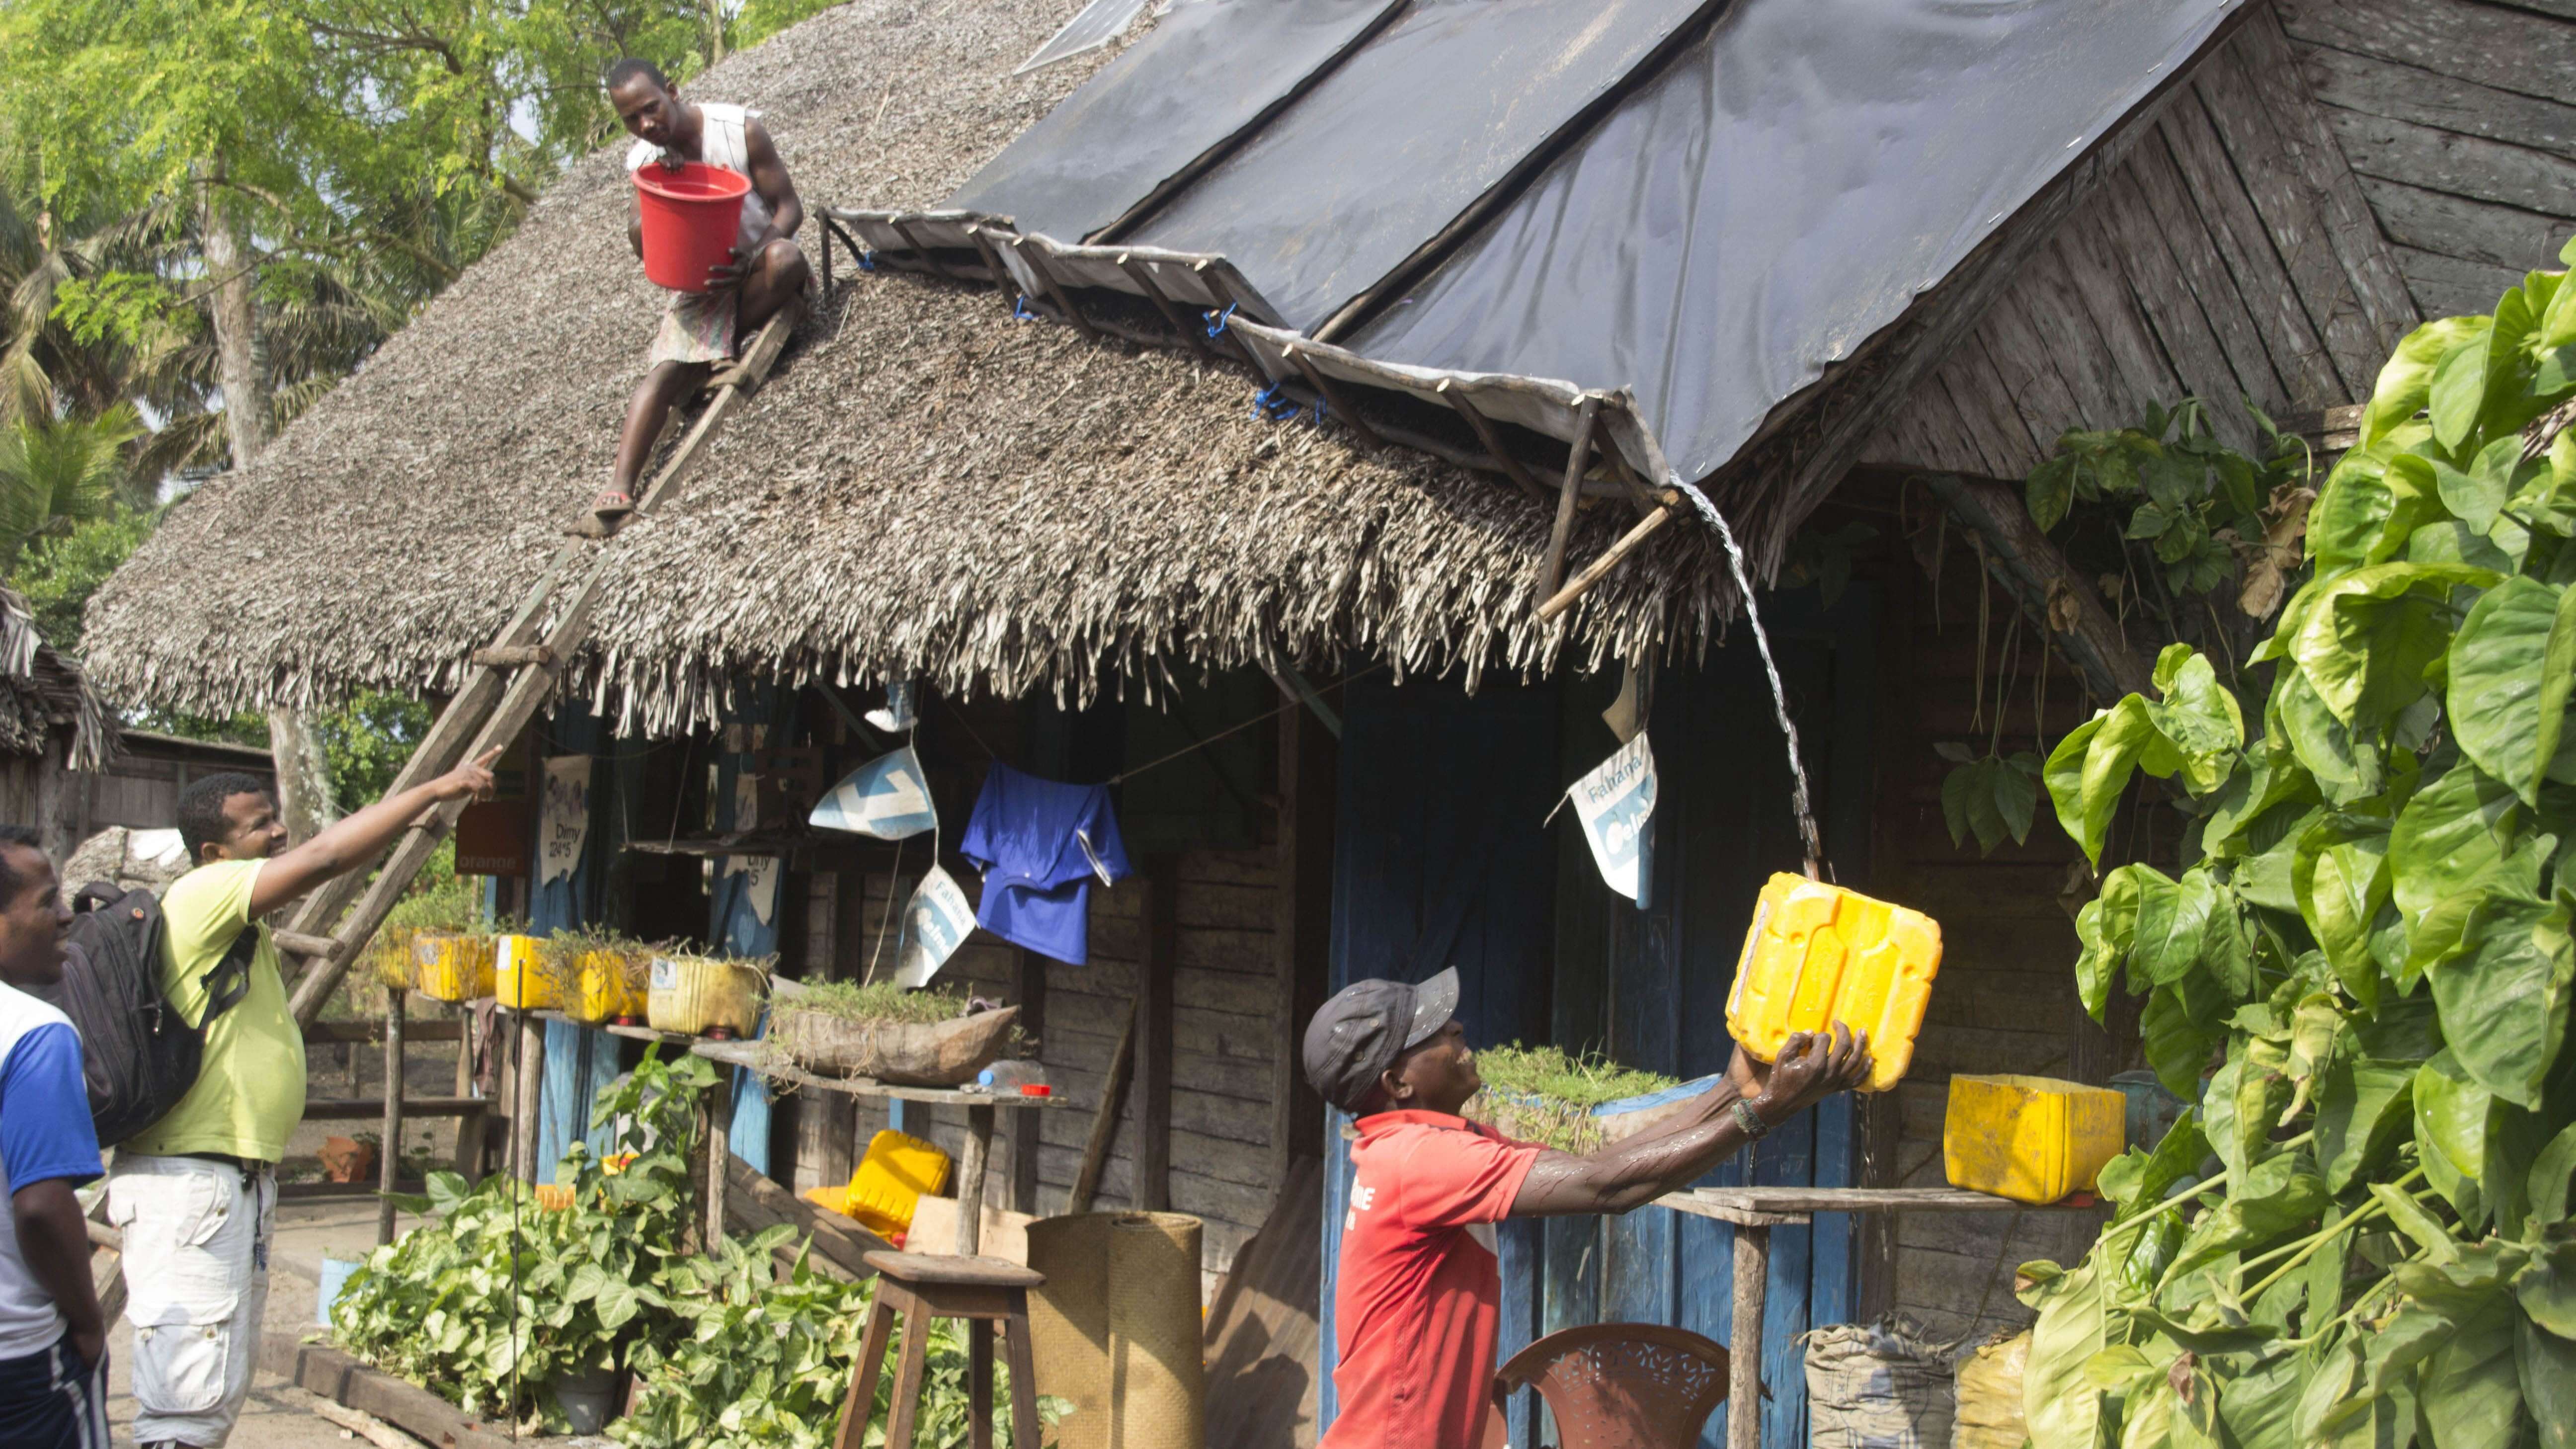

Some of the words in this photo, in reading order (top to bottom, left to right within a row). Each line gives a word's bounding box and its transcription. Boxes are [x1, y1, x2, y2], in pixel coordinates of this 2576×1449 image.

[1587, 755, 1642, 804] Fahana
[556, 822, 581, 843] Dimy
[459, 856, 517, 873] orange
[935, 881, 966, 927] Fahana
